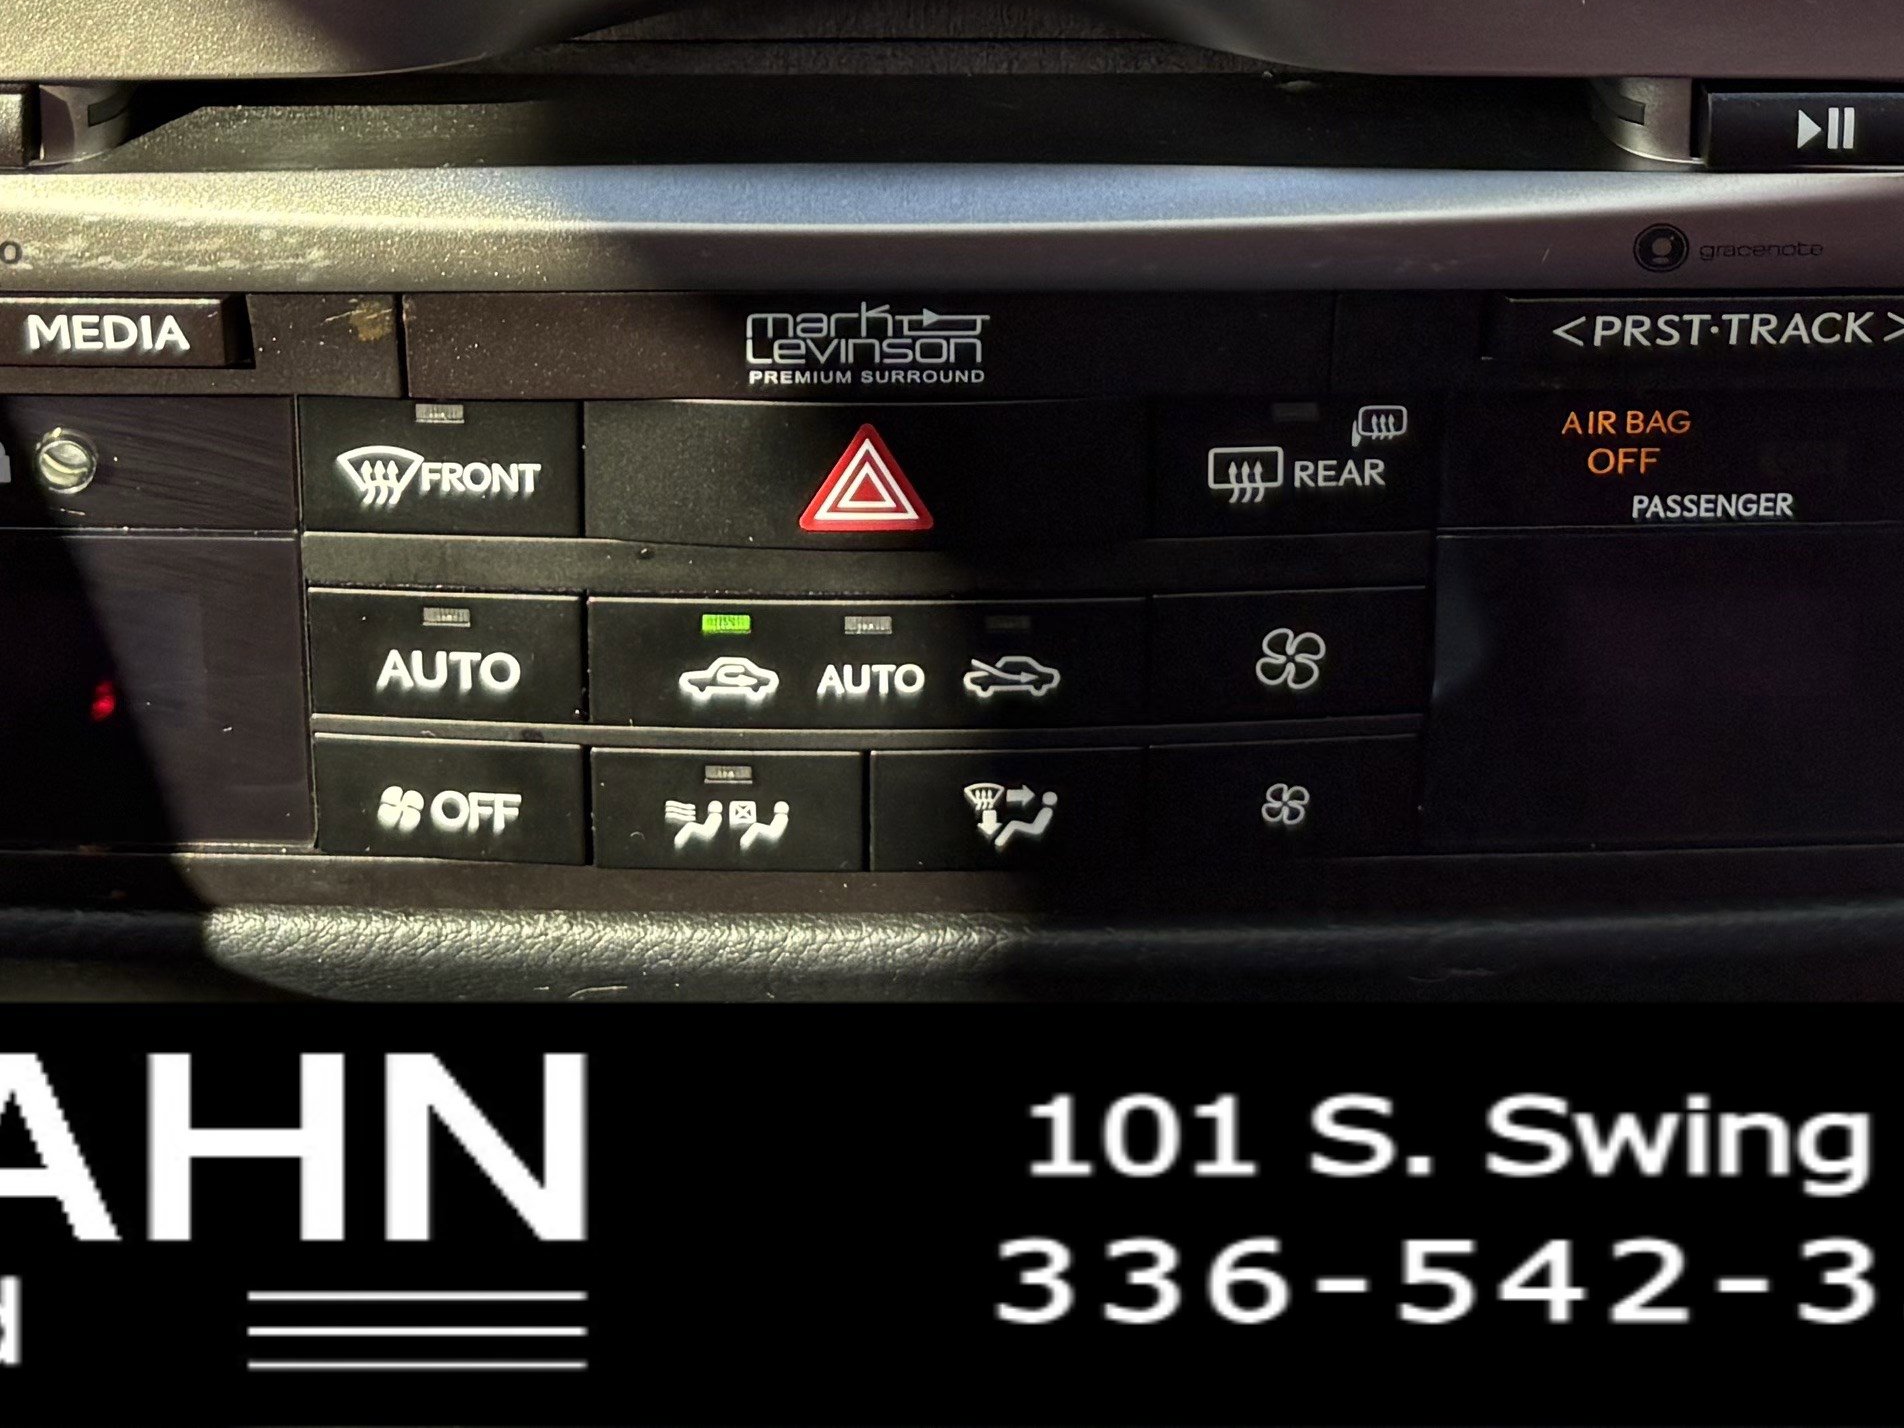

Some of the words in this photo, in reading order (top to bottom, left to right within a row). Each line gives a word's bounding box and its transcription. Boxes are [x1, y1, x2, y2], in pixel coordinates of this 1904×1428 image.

[1698, 240, 1825, 261] gracenote
[26, 313, 191, 352] MEDIA
[748, 369, 852, 385] PREMIUM
[860, 369, 986, 385] SURROUND
[1561, 410, 1617, 435] AIR
[1625, 409, 1692, 435] BAG
[1293, 458, 1386, 488] REAR
[1587, 447, 1661, 475] OFF
[420, 461, 543, 495] FRONT
[1631, 492, 1794, 520] PASSENGER
[376, 648, 522, 693] AUTO
[816, 663, 926, 697] AUTO
[429, 790, 523, 832] OFF
